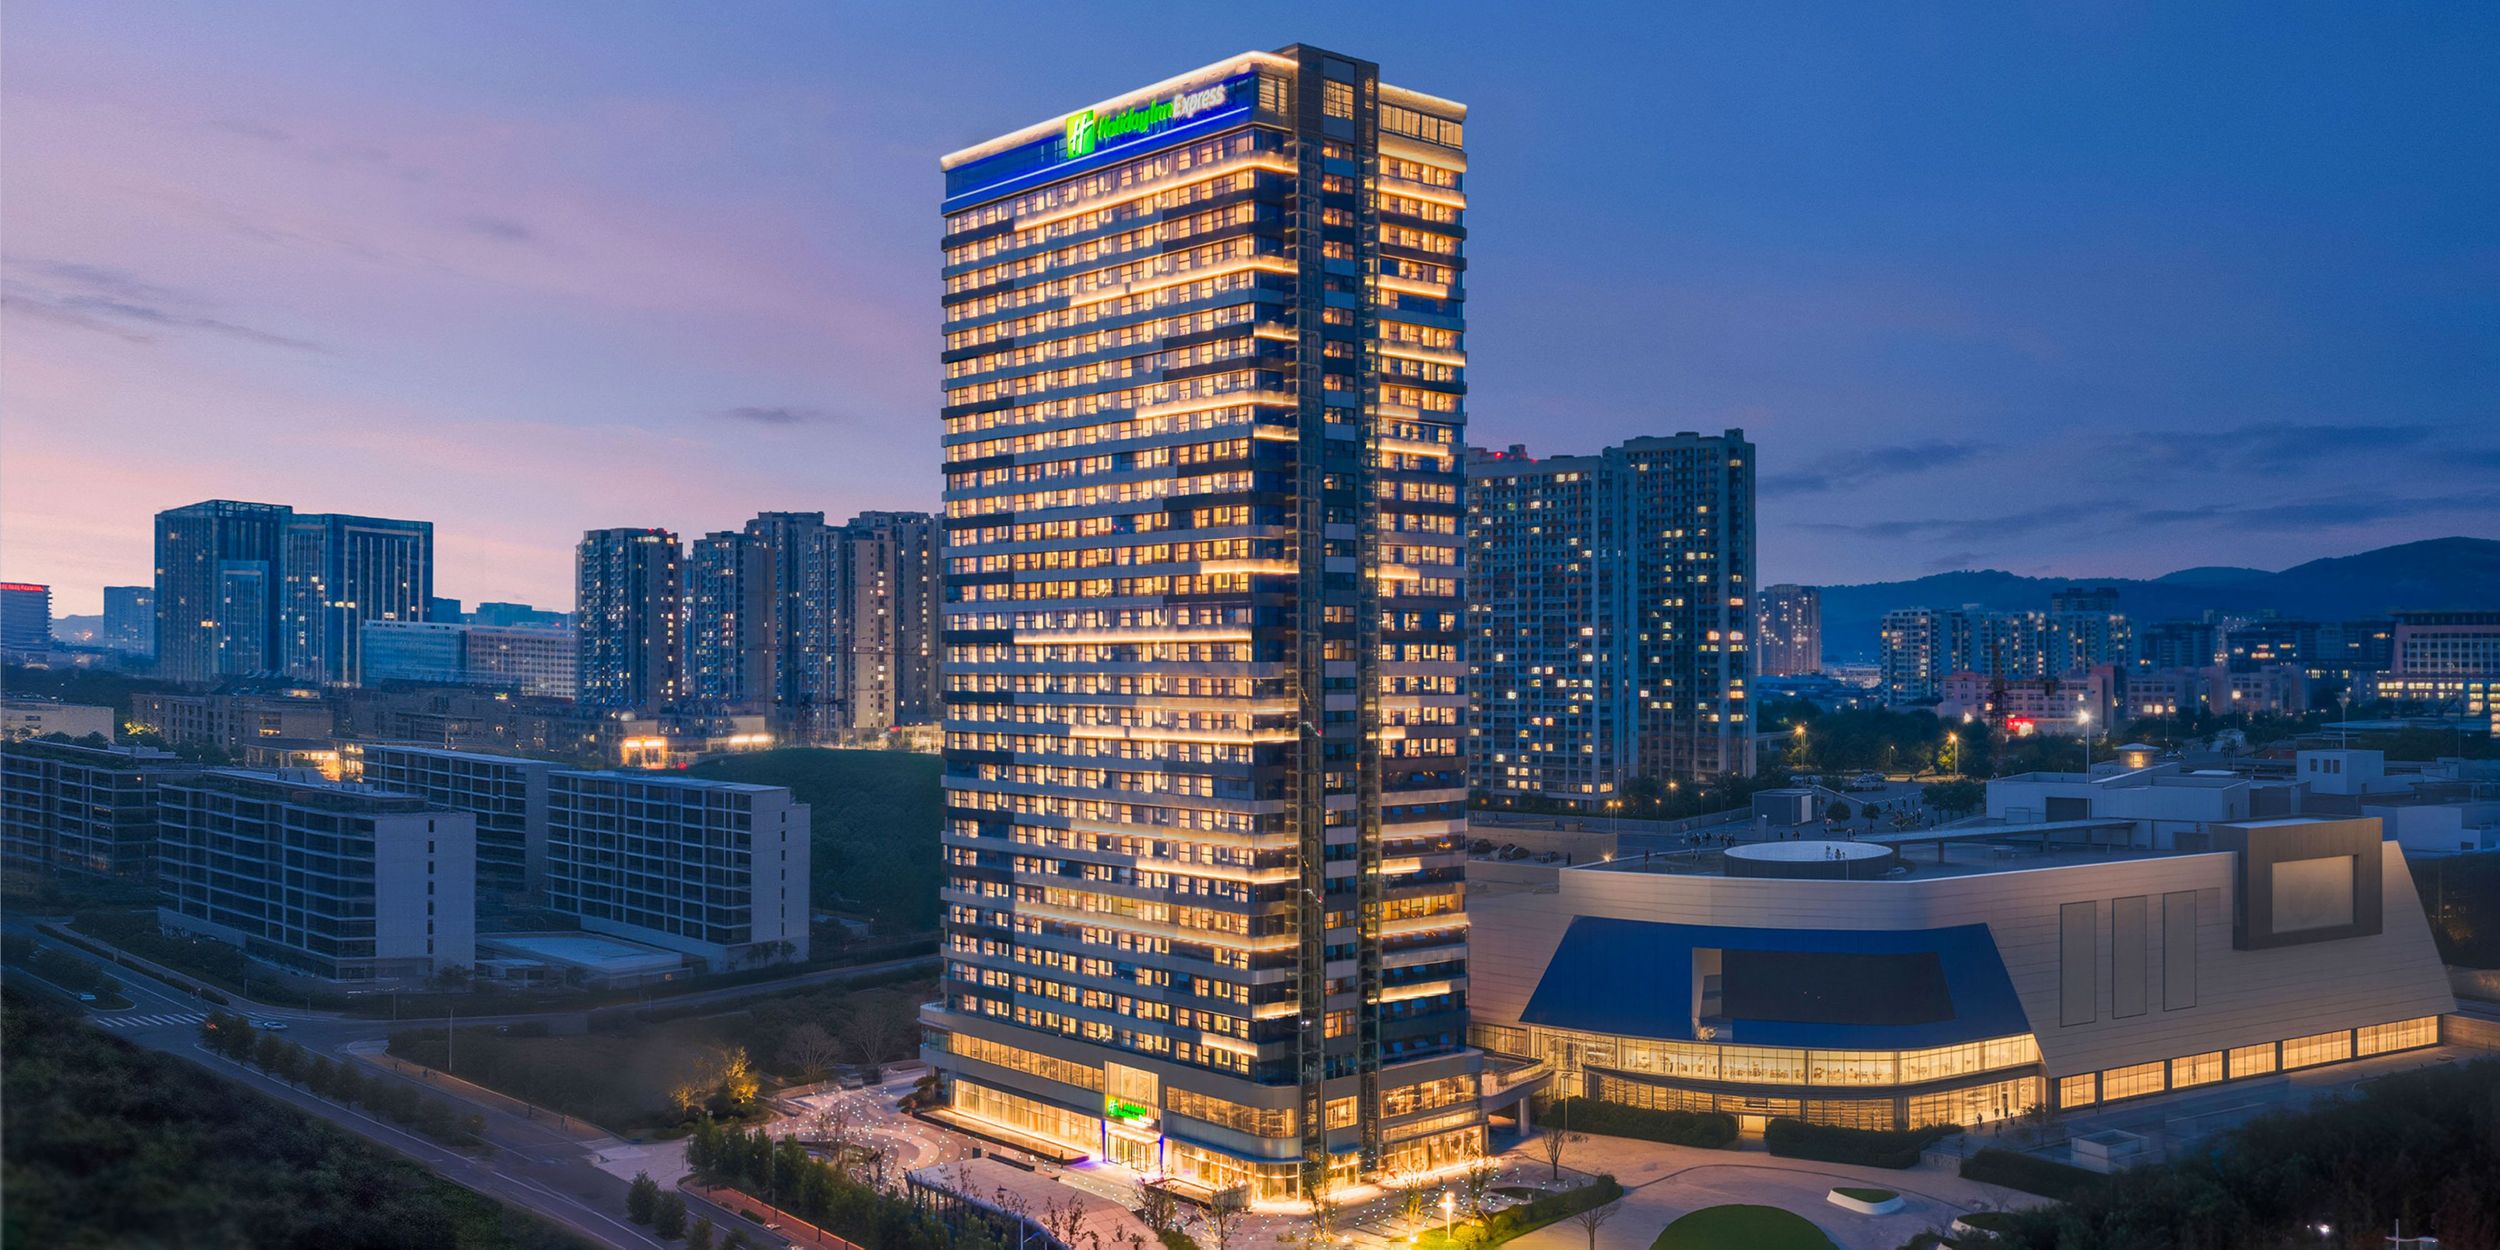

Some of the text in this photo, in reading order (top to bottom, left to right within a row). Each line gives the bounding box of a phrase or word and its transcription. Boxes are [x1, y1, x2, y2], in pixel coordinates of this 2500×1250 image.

[1097, 84, 1226, 140] Holiday Inn Express
